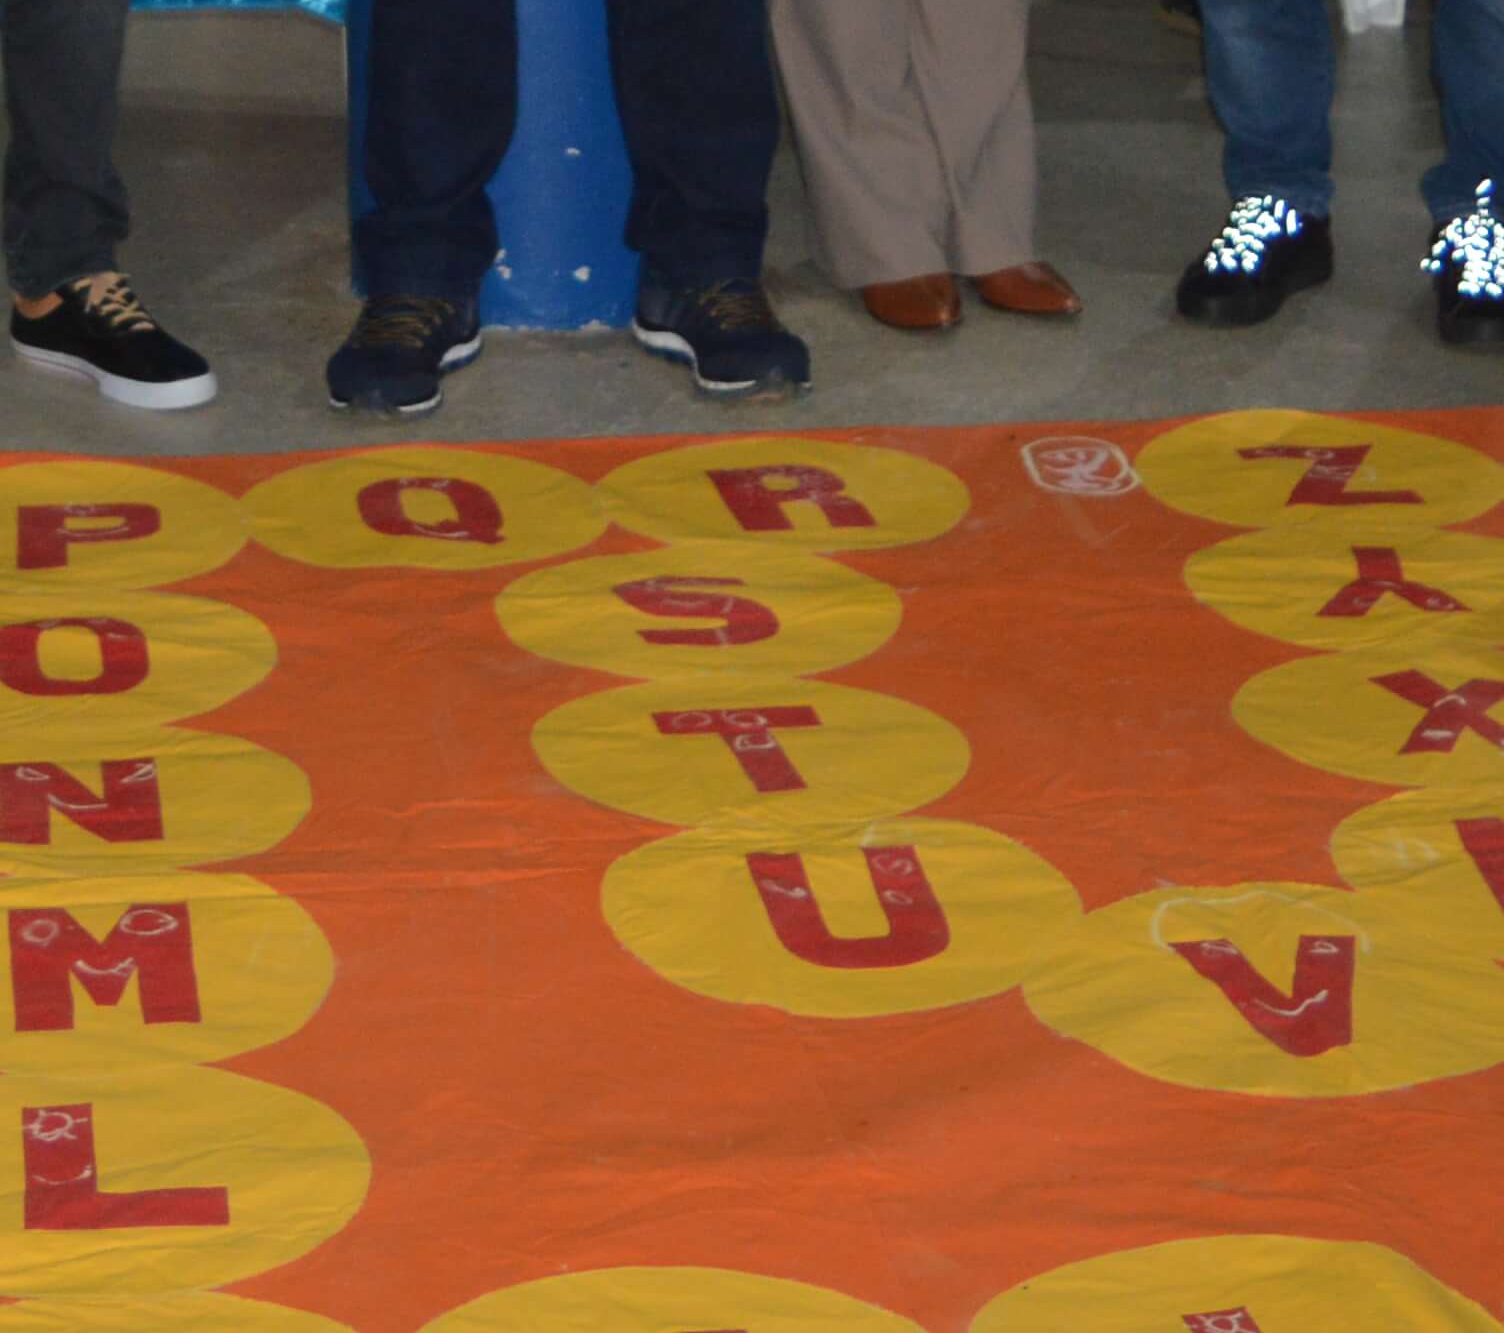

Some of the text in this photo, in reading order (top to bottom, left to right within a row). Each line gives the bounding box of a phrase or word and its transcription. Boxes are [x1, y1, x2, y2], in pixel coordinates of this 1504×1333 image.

[357, 477, 507, 543] Q
[704, 464, 878, 532] R
[1236, 444, 1425, 506] Z
[17, 502, 161, 569] P
[611, 577, 780, 646] S
[650, 706, 822, 793] T
[746, 845, 951, 970] U
[8, 901, 201, 1032] M
[1168, 936, 1356, 1057] V
[22, 1103, 229, 1230] L
